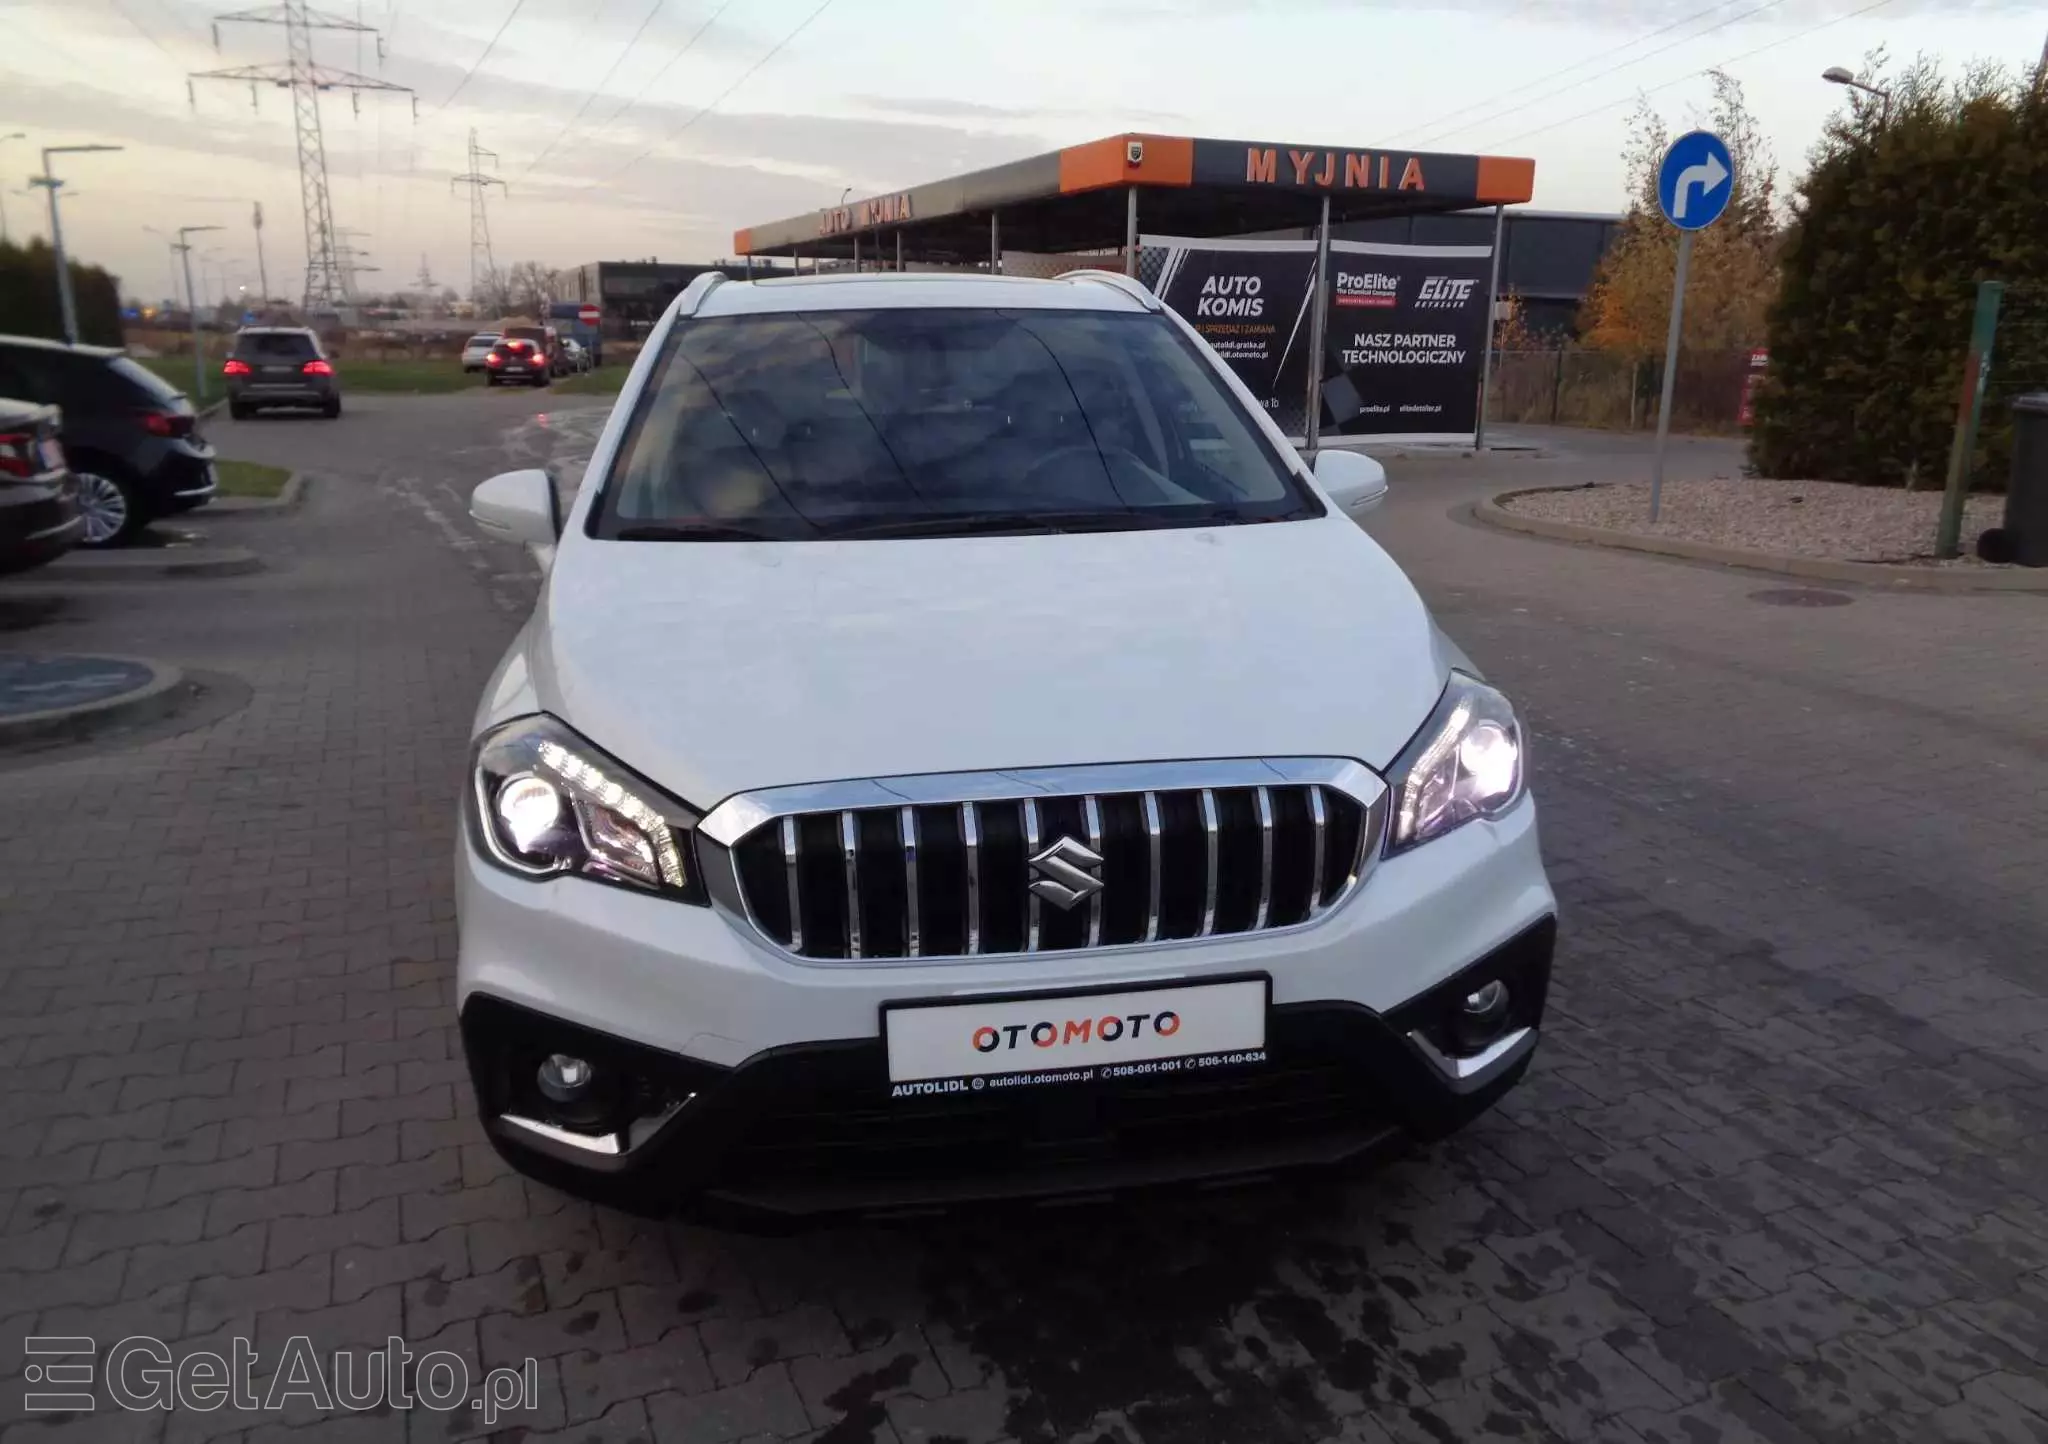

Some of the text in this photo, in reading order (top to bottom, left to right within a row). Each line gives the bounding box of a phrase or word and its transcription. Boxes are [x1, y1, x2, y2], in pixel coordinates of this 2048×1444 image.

[1246, 147, 1425, 191] MYJNIA
[1201, 275, 1262, 295] AUTO
[1197, 297, 1265, 317] KOMIS
[1354, 333, 1457, 348] NASZ PARTNER
[1342, 350, 1466, 364] TECHNOLOGICZNY
[972, 1011, 1180, 1053] OTOMOTO
[892, 1079, 969, 1097] AUTOLIDL
[989, 1069, 1094, 1088] autolidl.otomoto.pl
[1113, 1060, 1181, 1076] 508-061-001
